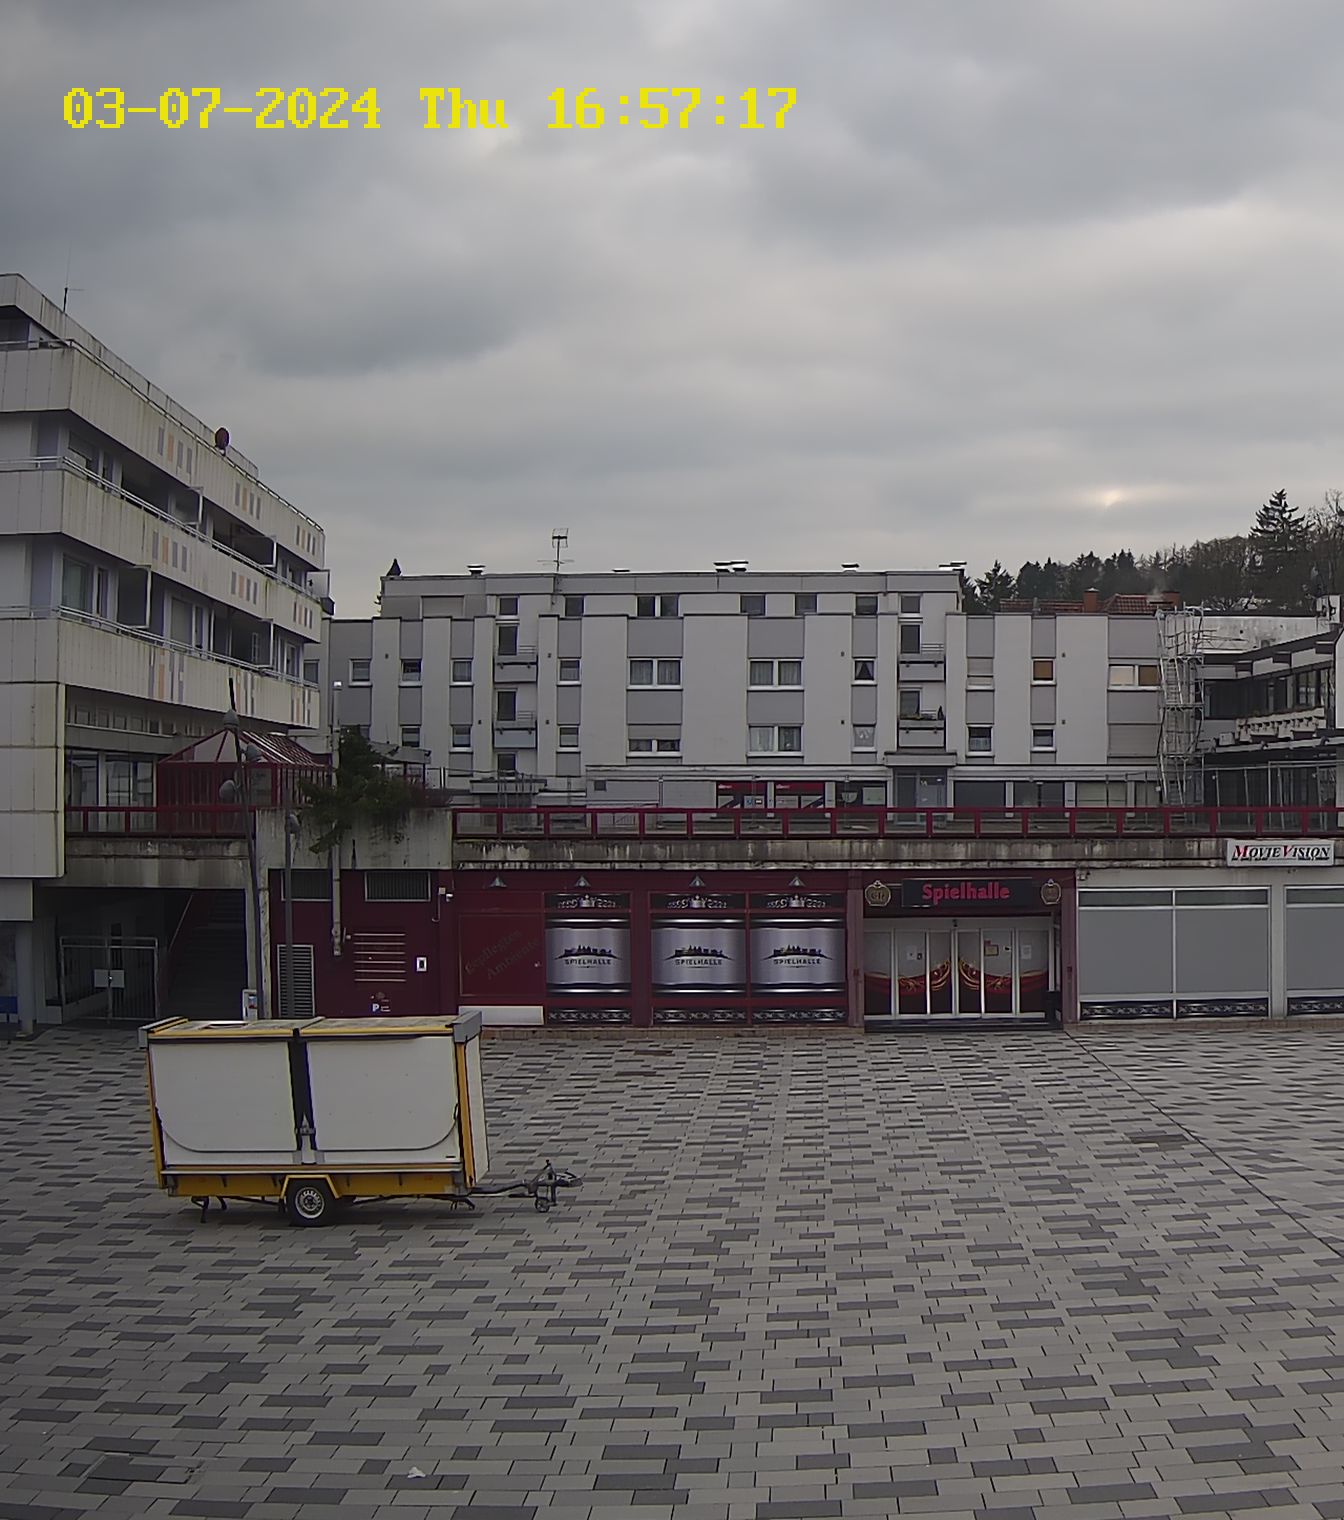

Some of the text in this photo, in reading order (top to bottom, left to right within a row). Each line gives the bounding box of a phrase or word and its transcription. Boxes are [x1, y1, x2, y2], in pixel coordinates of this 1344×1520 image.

[921, 881, 1011, 905] Spielhalle
[564, 957, 612, 966] SPIELHALLE
[675, 957, 723, 967] SPIELHALLE
[773, 957, 822, 966] SPIELHALLE
